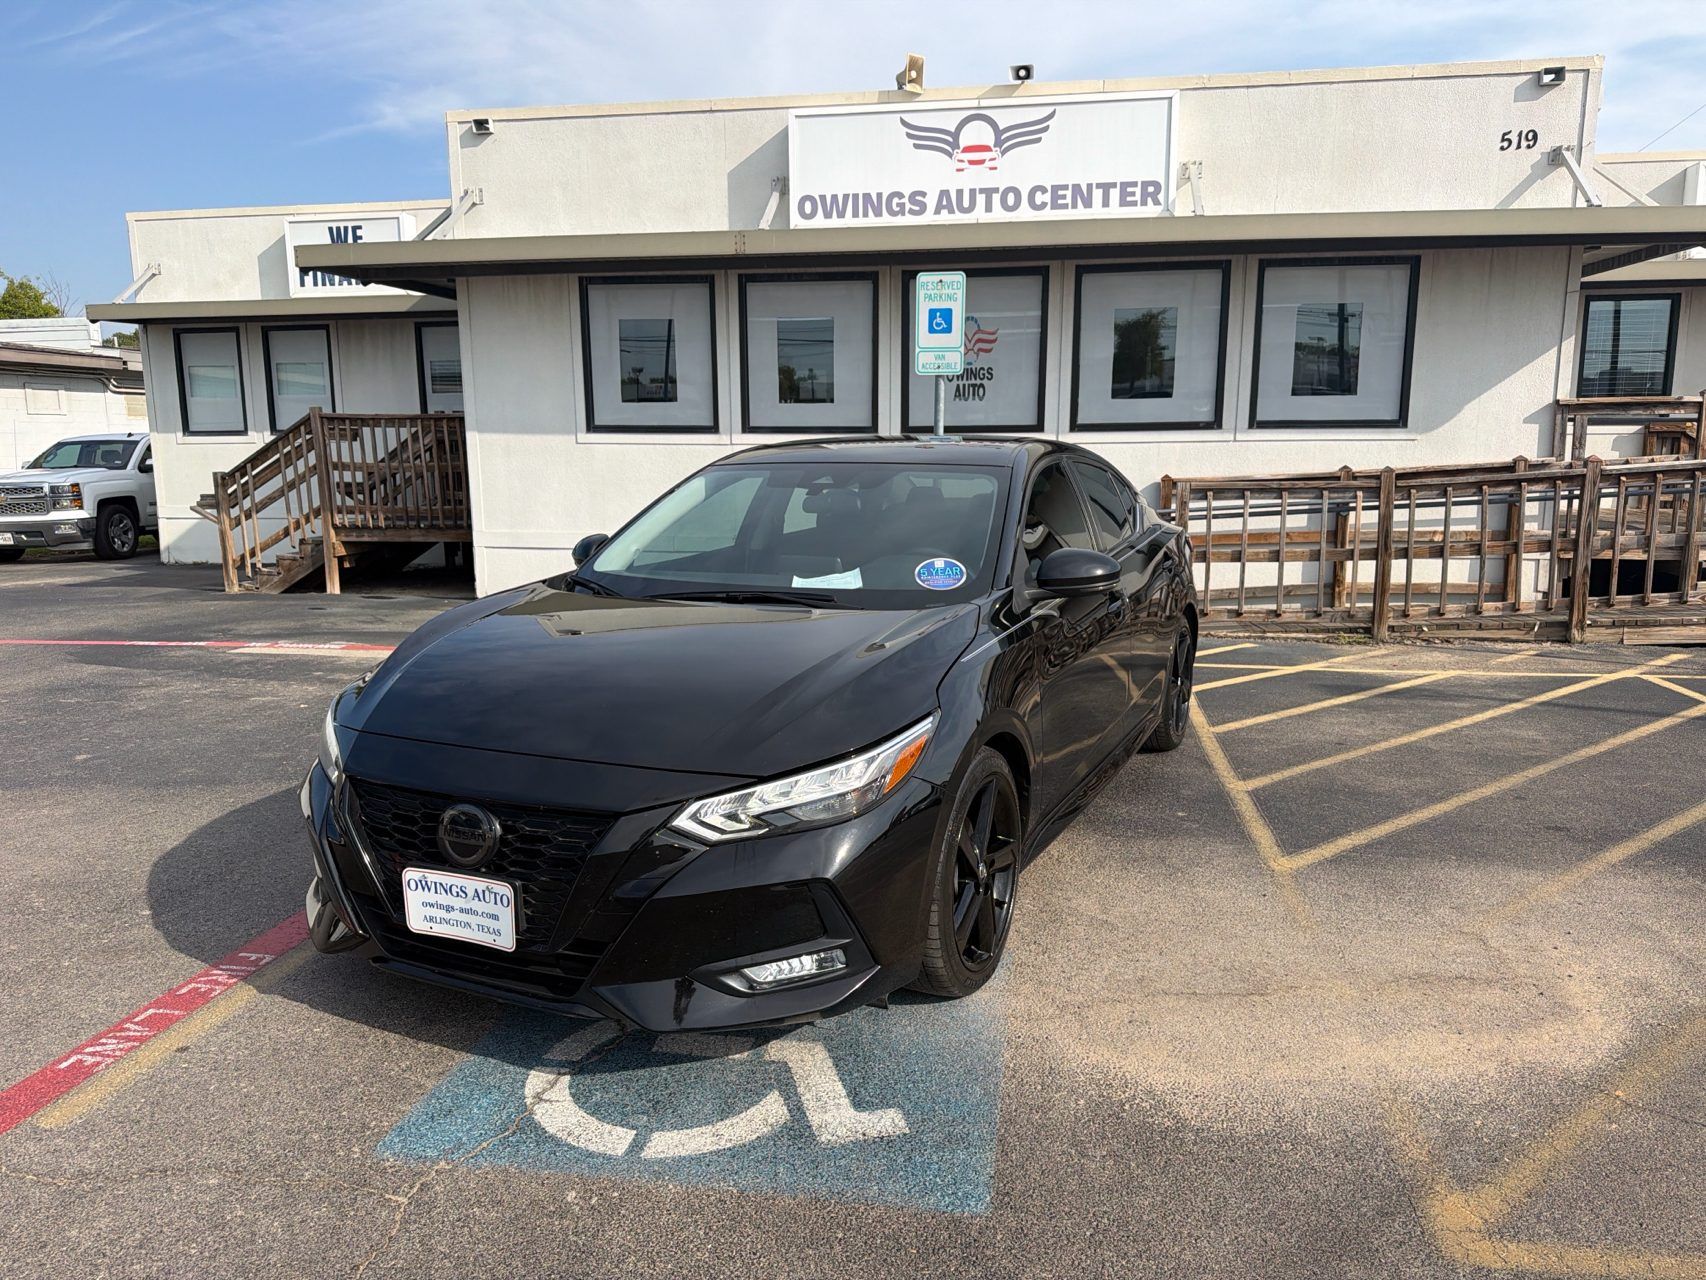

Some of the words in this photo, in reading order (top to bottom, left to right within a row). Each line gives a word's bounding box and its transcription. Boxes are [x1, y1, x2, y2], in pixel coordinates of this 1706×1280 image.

[1500, 129, 1538, 151] 519
[797, 190, 928, 220] OWINGS
[933, 184, 1022, 215] AUTO
[1027, 180, 1163, 212] CENTER
[920, 280, 961, 291] RESERVED
[923, 292, 958, 302] PARKING
[921, 361, 959, 370] ACCESSIBLE
[933, 353, 946, 361] VAN
[953, 383, 986, 401] AUTO
[920, 568, 927, 576] 5
[931, 567, 960, 575] YEAR
[444, 827, 486, 842] NISSAN
[407, 878, 468, 899] OWINGS
[472, 888, 510, 908] AUTO
[421, 901, 500, 922] owings-auto.com
[422, 914, 475, 932] ARLINGTON,
[476, 923, 502, 937] TEXAS
[175, 952, 276, 998] FIRE
[57, 1008, 187, 1073] LANE
